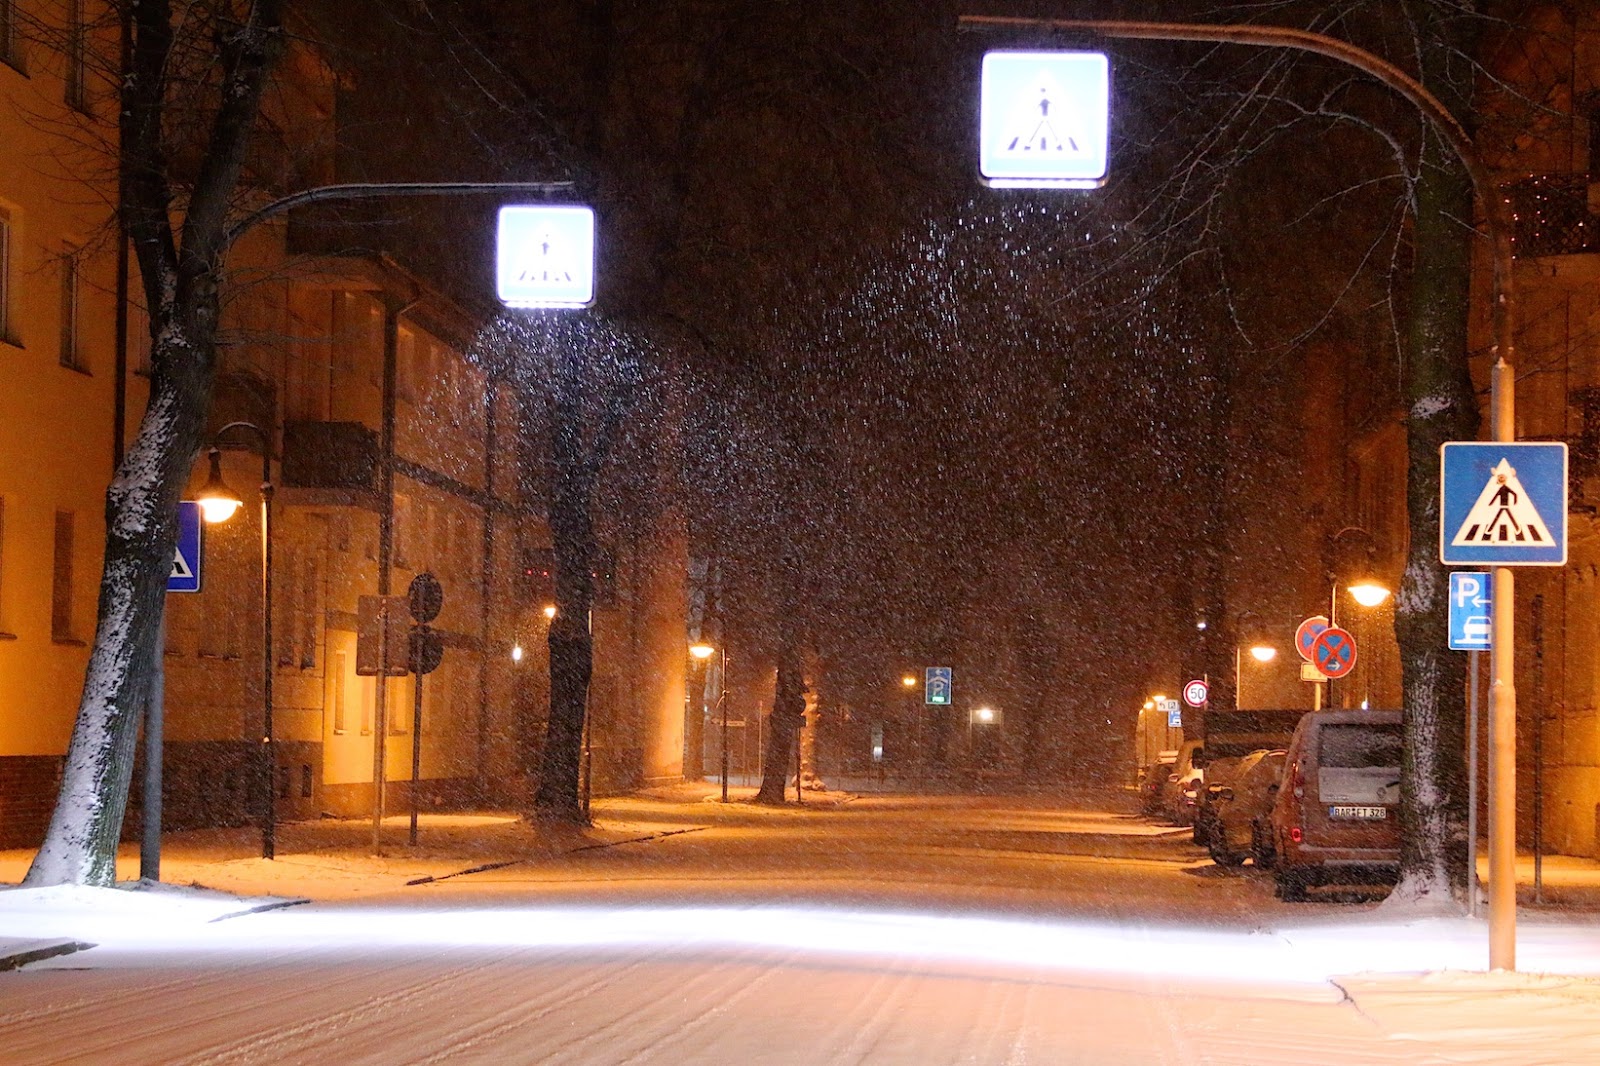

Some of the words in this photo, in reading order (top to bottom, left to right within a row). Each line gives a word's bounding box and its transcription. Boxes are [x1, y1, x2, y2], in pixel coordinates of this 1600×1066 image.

[1458, 577, 1480, 608] P
[1190, 687, 1205, 700] 50
[1369, 808, 1385, 818] 328
